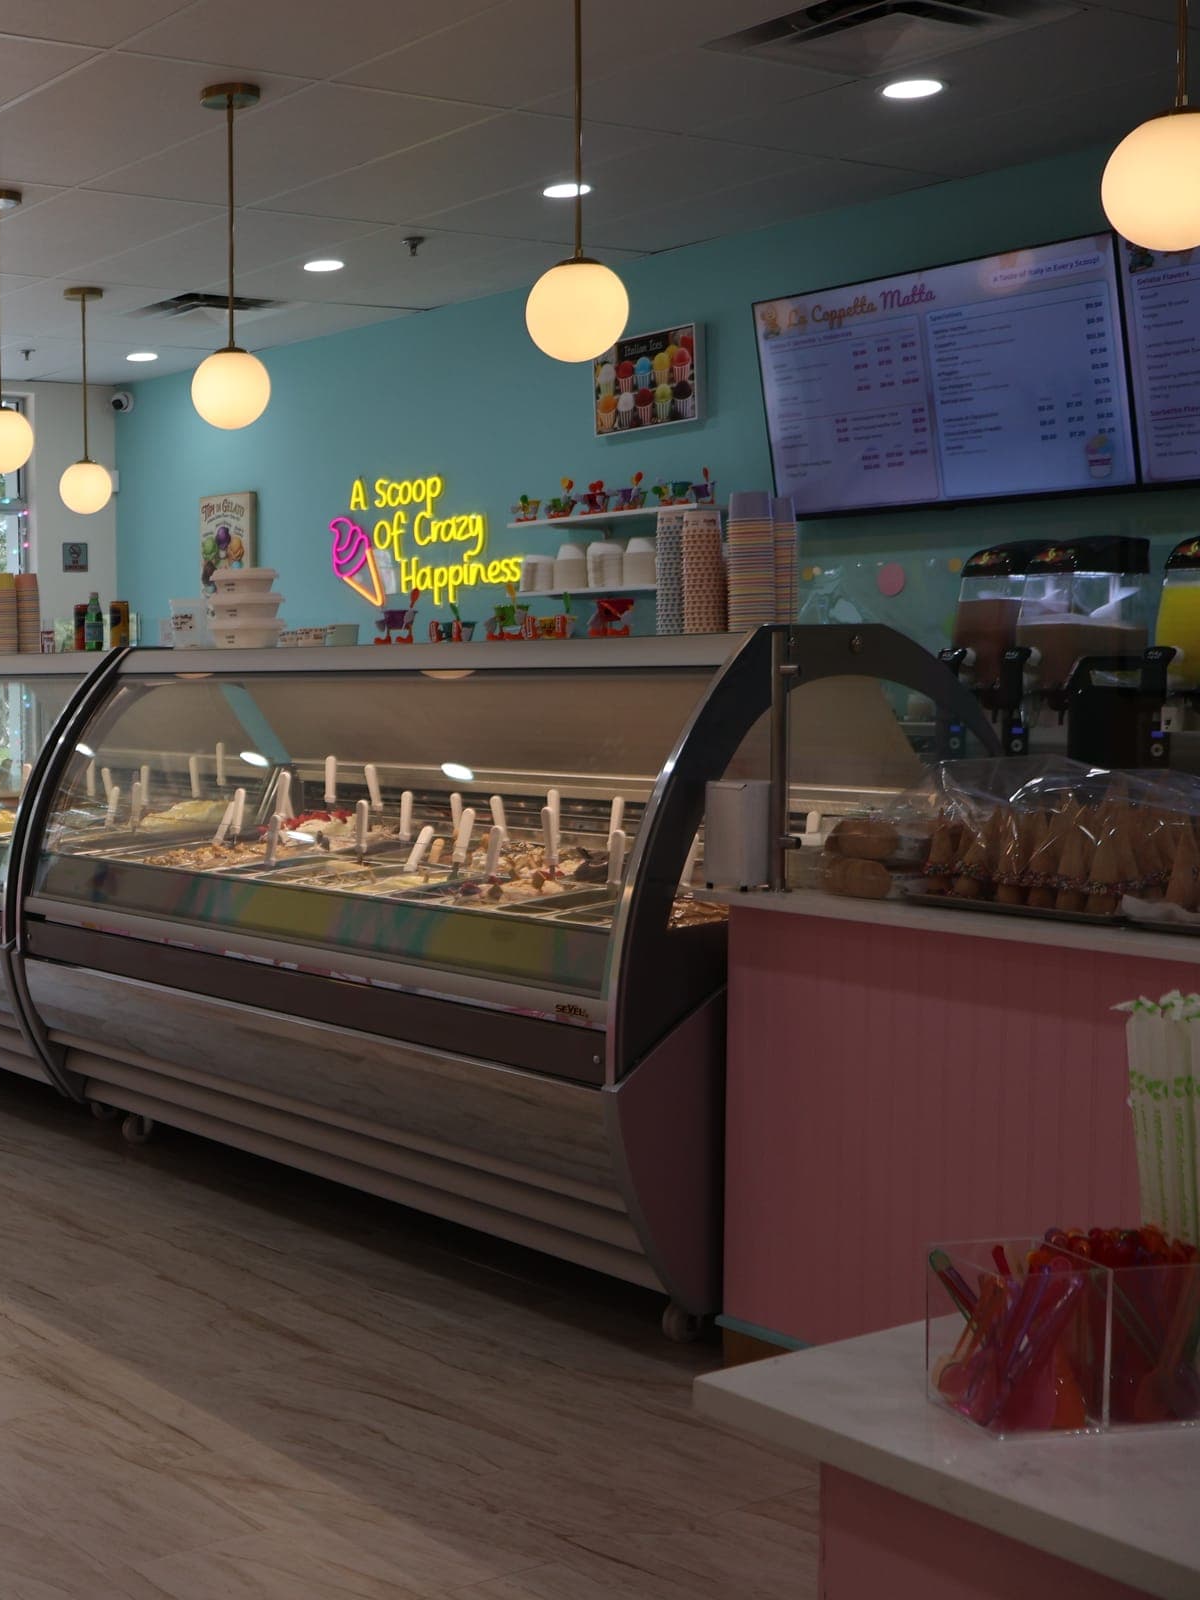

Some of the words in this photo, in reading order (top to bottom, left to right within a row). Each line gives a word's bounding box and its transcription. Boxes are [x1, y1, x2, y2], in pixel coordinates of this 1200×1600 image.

[811, 295, 878, 330] Coppetta
[879, 282, 937, 312] Matta
[623, 343, 648, 358] Italian
[648, 338, 665, 352] Ices
[349, 478, 369, 512] A
[413, 511, 486, 558] Crazy
[400, 554, 525, 606] Happiness
